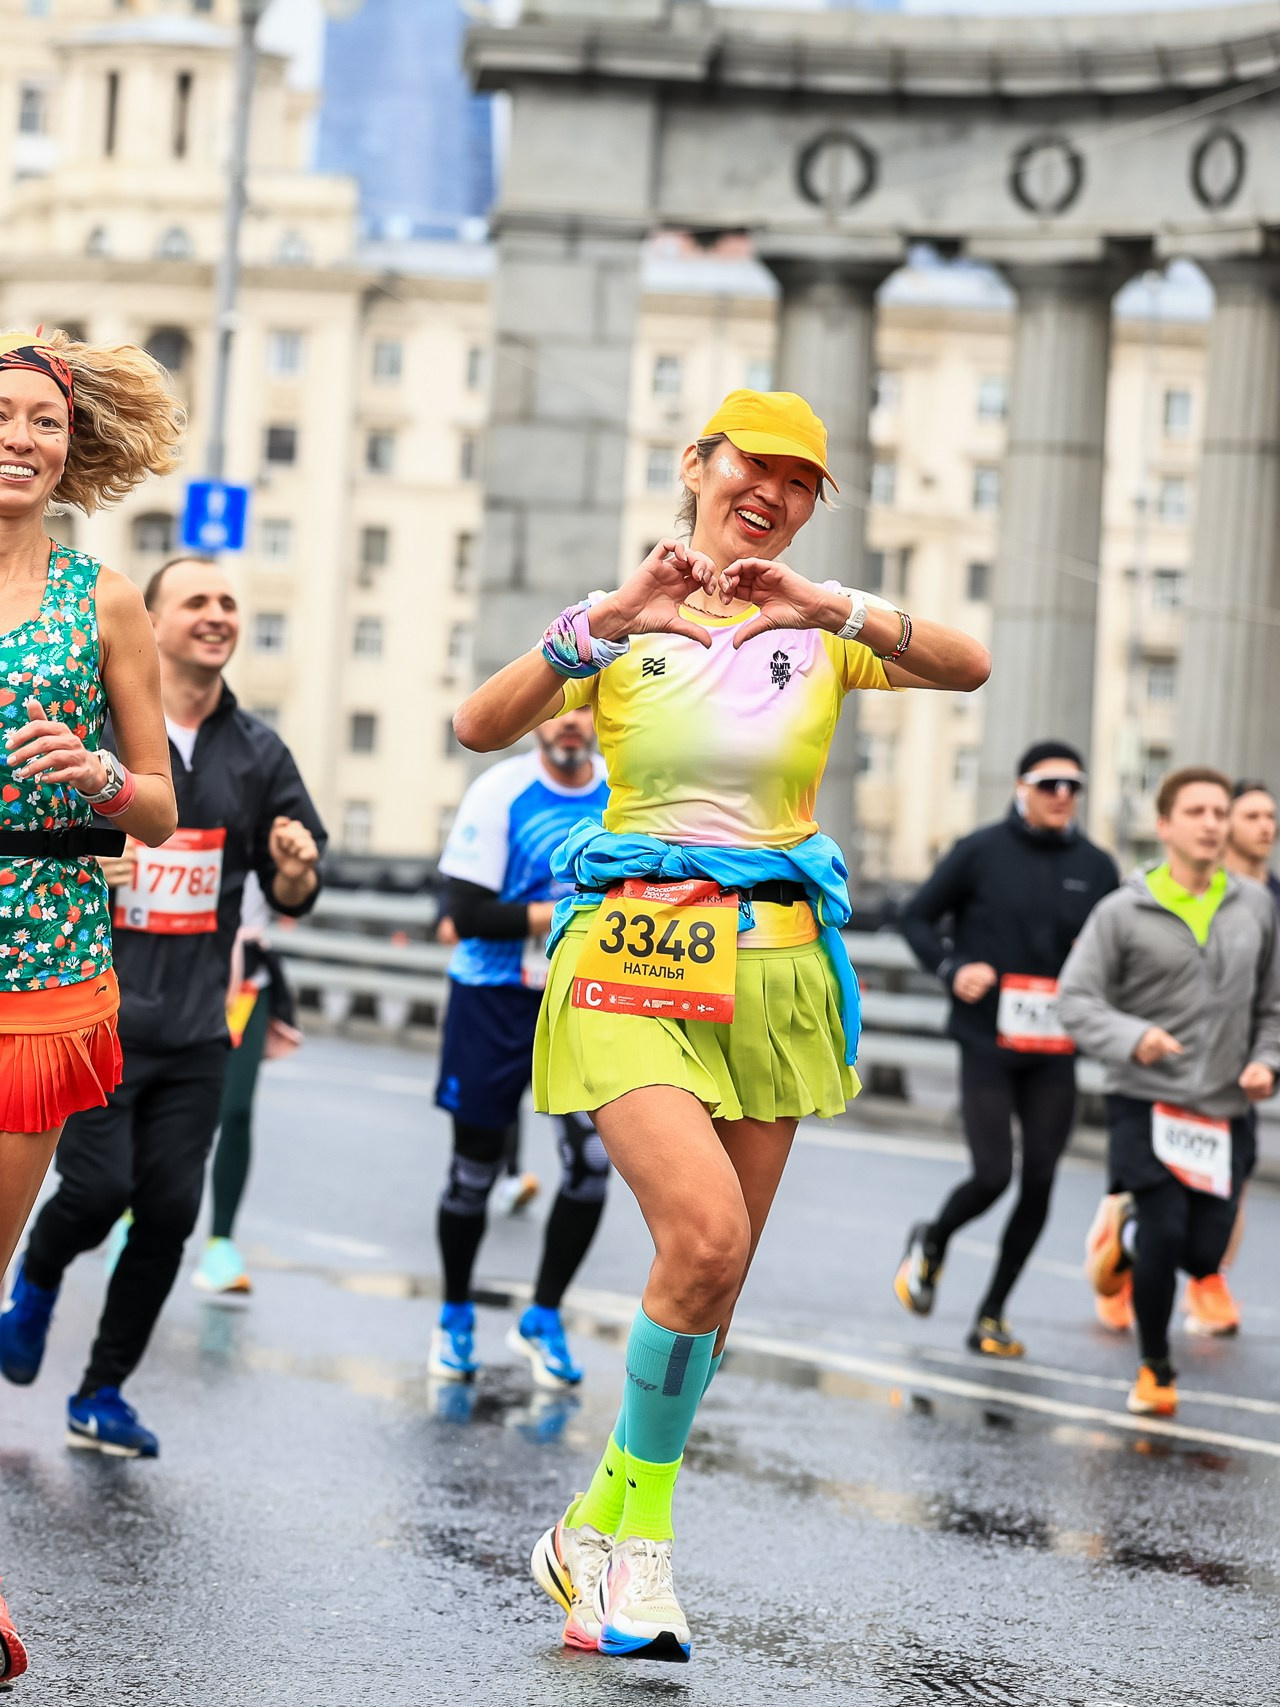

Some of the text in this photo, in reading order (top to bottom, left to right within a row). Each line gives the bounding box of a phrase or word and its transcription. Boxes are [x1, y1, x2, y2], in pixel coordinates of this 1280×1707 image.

[599, 910, 716, 964] 3348
[623, 962, 685, 980] НАТАЛЬЯ
[585, 982, 603, 1007] C
